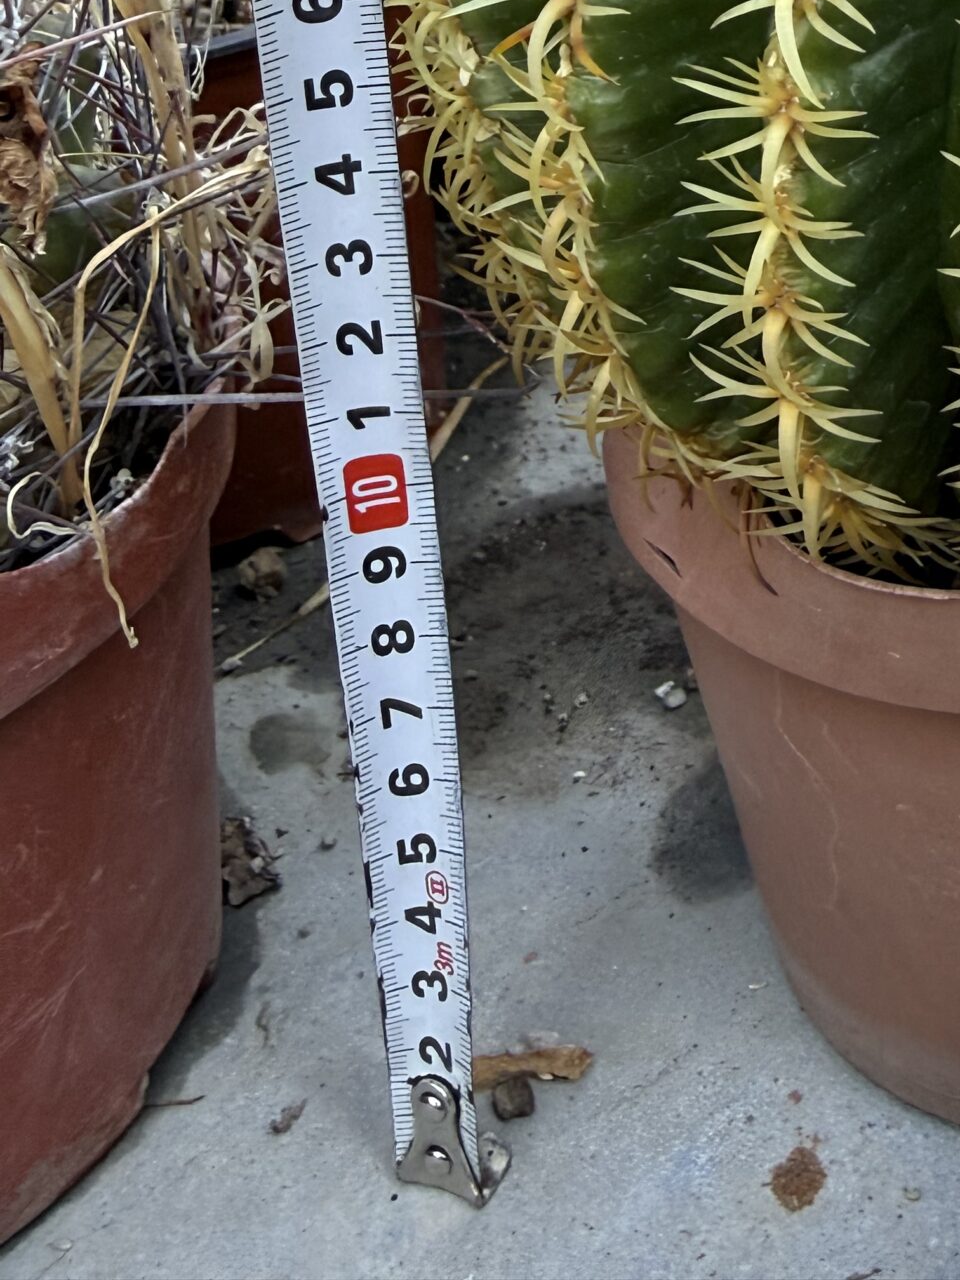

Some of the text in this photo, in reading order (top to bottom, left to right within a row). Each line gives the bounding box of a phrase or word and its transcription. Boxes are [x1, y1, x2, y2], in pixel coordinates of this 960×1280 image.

[304, 70, 353, 111] 5
[315, 154, 361, 195] 4
[325, 240, 372, 276] 3
[336, 320, 383, 355] 2
[347, 407, 390, 429] 1
[352, 475, 401, 513] 10
[363, 546, 406, 583] 9
[371, 620, 414, 656] 8
[380, 698, 422, 729] 7
[389, 764, 429, 796] 6
[397, 834, 436, 865] 5
[405, 901, 441, 934] 4
[412, 971, 447, 1001] 3
[419, 1037, 452, 1072] 2
